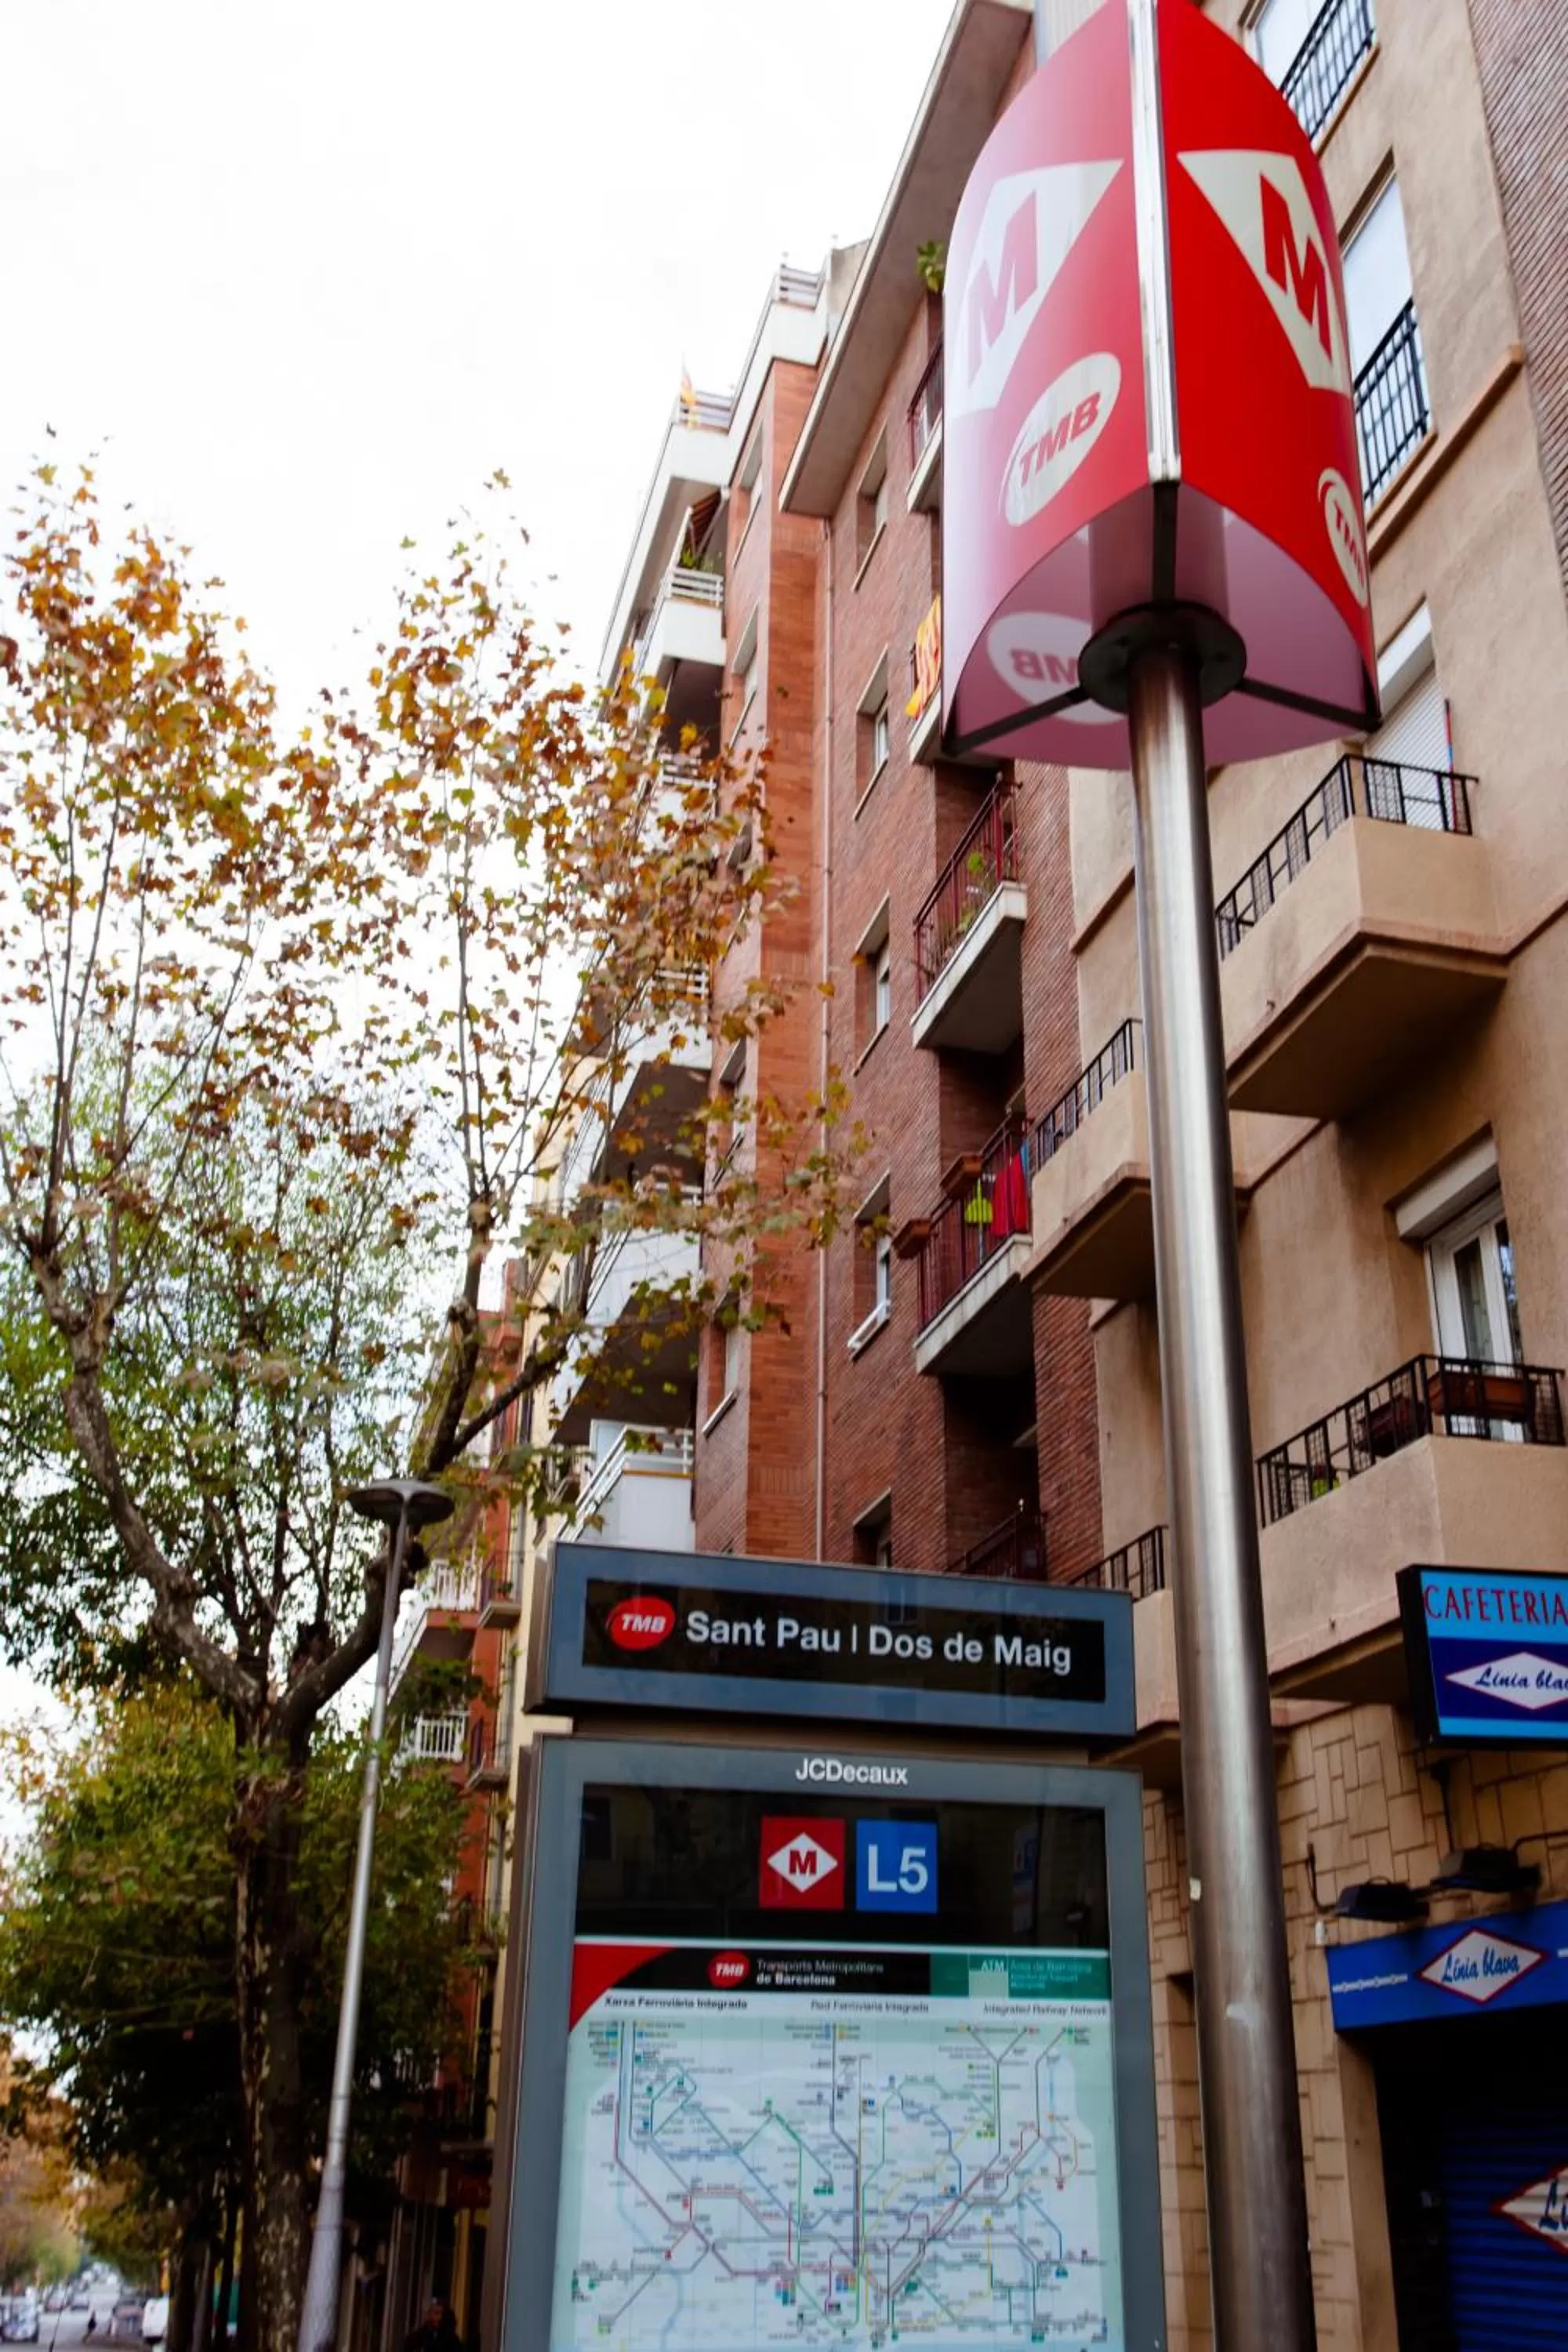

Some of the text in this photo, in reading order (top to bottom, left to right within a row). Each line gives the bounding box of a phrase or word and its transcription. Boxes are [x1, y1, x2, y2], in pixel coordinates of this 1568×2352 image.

[967, 189, 1039, 389] M
[1259, 173, 1332, 364] M
[1018, 391, 1102, 488] TMB
[1421, 1584, 1568, 1627] CAFETERIA
[620, 1613, 666, 1634] TMB
[686, 1610, 766, 1647] Sant
[776, 1617, 841, 1653] Pau
[869, 1624, 934, 1661] Dos
[943, 1632, 983, 1663] de
[993, 1635, 1072, 1676] Maig
[795, 1757, 909, 1786] JCDecaux
[789, 1843, 929, 1894] M L5
[714, 1962, 745, 1977] TMB
[757, 1973, 836, 1986] de Barcelona
[981, 1958, 1004, 1973] ATM
[1483, 1946, 1519, 1976] blava
